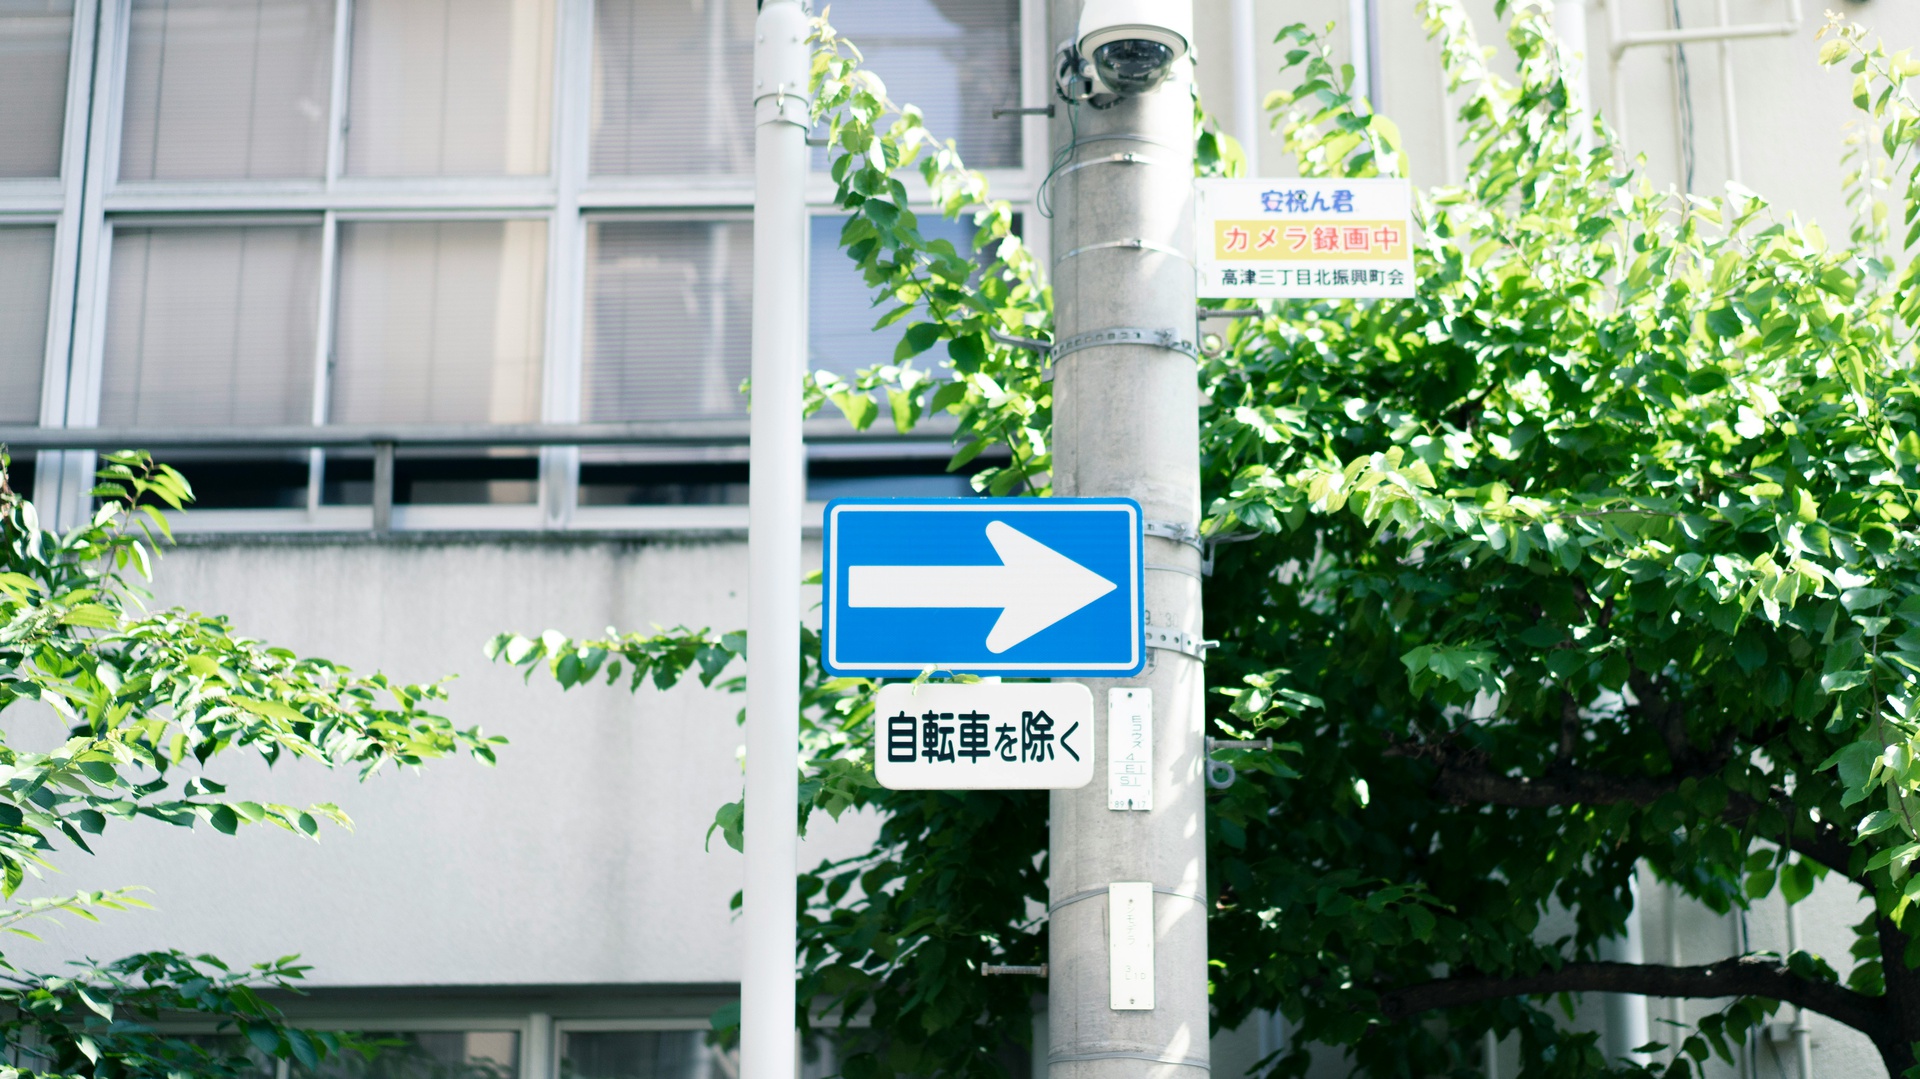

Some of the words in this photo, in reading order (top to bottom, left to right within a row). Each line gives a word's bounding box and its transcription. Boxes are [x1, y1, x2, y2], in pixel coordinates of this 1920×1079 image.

[1225, 227, 1399, 251] カメラ録画中
[1221, 269, 1404, 286] 高津三丁目北振興町会
[888, 710, 1080, 764] 自転車を除く
